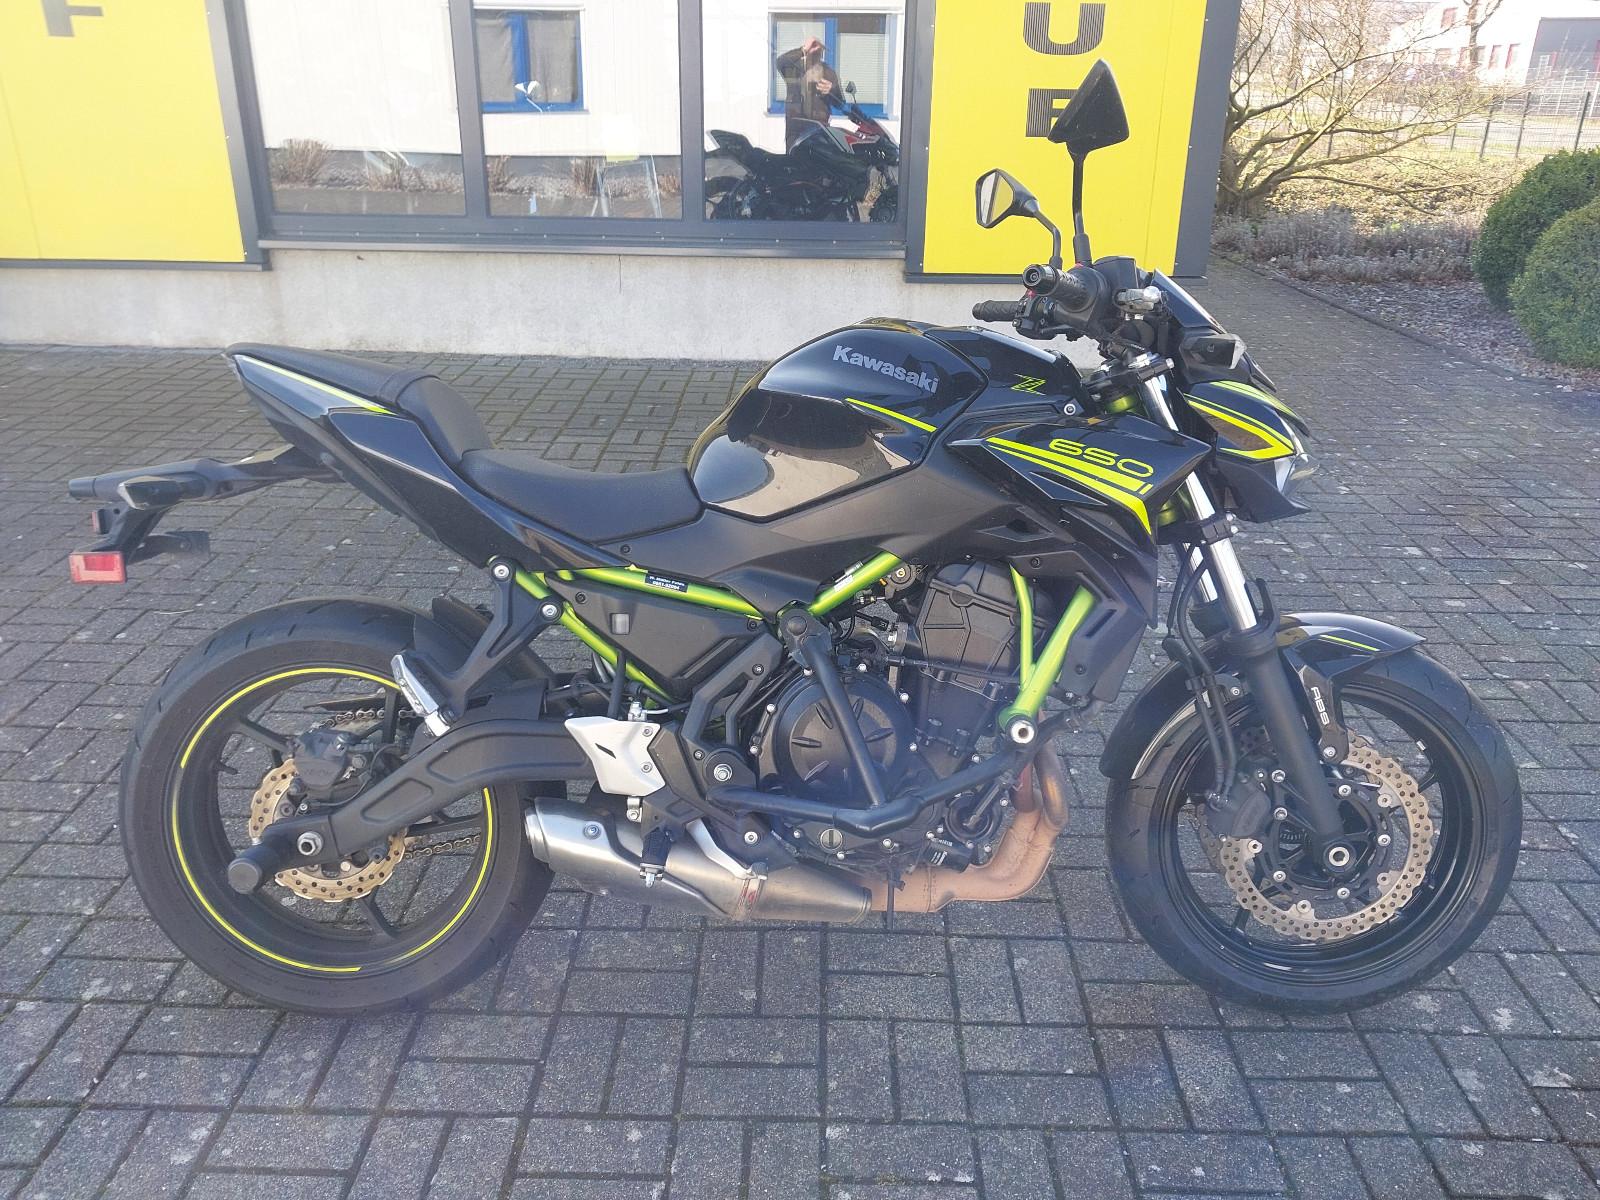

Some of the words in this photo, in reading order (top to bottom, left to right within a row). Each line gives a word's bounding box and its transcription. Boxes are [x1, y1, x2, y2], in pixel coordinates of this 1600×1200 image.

[832, 344, 940, 394] Kawasaki
[1048, 438, 1154, 478] 650
[1310, 686, 1330, 726] ABS
